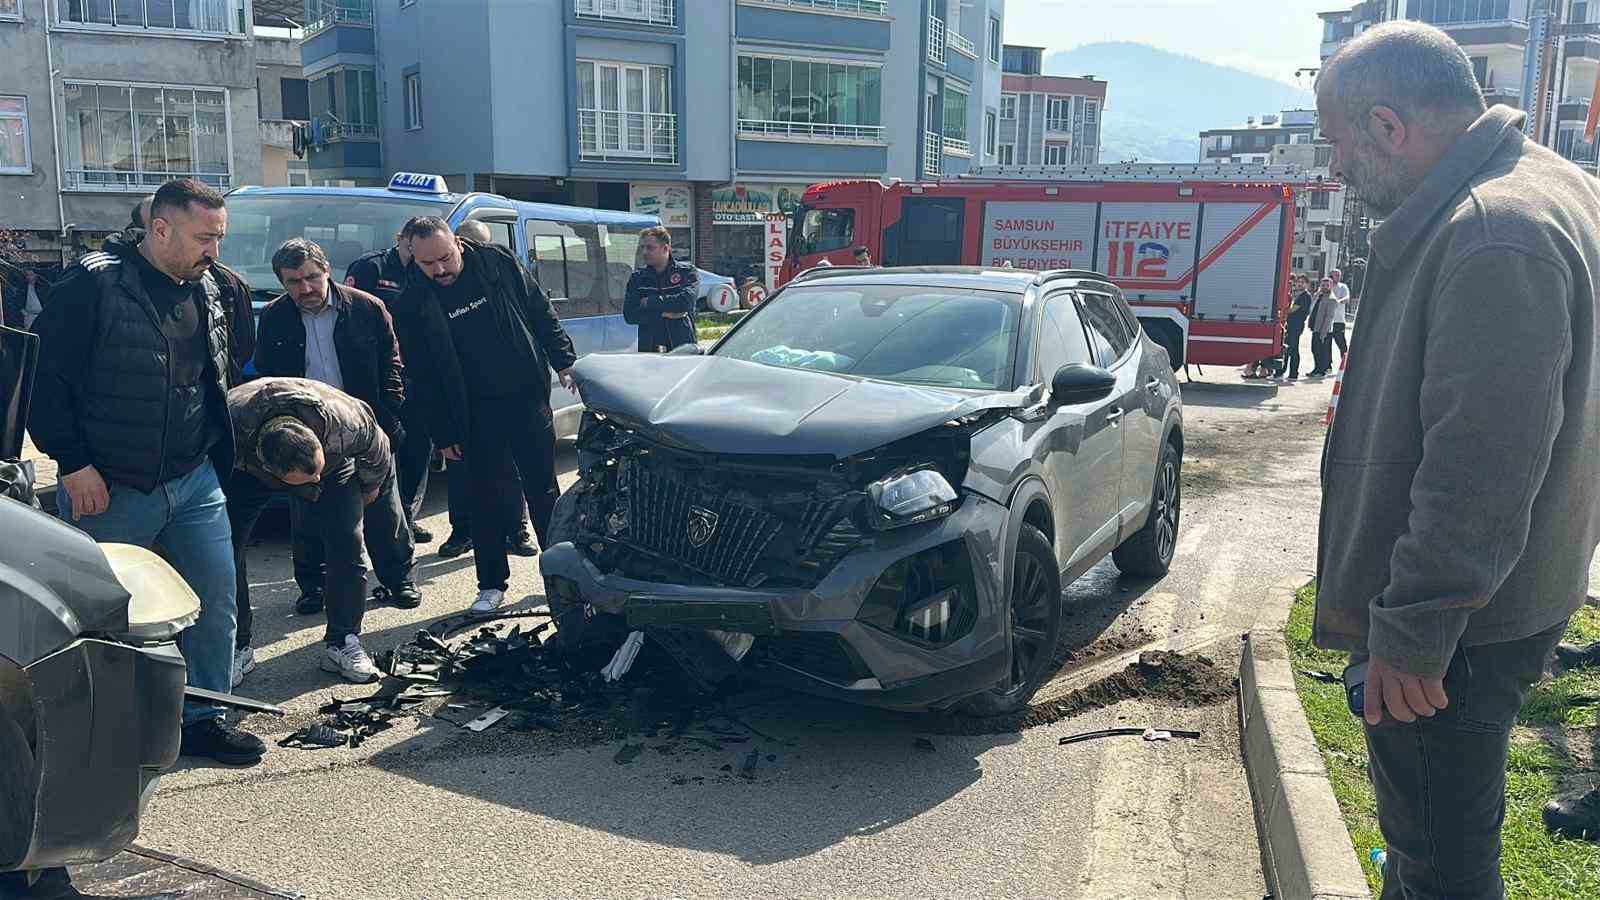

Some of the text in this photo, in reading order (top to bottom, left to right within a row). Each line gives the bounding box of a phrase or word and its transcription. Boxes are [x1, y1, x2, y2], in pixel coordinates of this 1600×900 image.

[714, 213, 733, 221] OTO
[767, 212, 786, 222] OTO
[994, 219, 1056, 232] SAMSUN
[1107, 240, 1169, 278] 112
